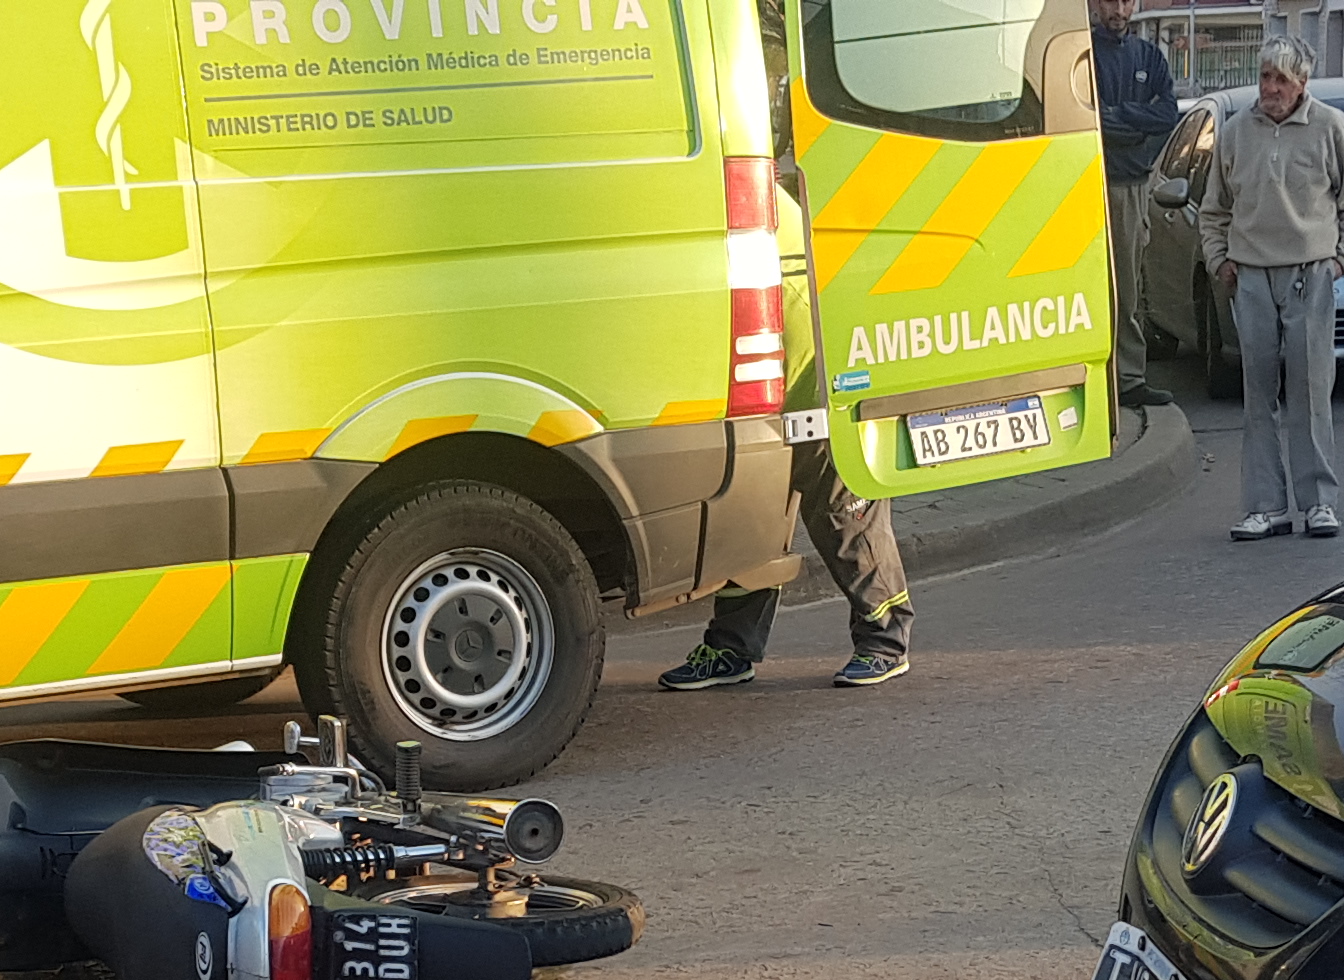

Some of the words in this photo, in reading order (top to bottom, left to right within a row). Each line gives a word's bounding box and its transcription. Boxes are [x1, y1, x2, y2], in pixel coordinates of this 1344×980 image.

[190, 0, 650, 47] PROVINCIA
[200, 62, 288, 82] Sistema
[295, 59, 321, 77] de
[328, 54, 420, 76] Atención
[426, 51, 500, 71] Médica
[506, 49, 530, 66] de
[536, 43, 652, 67] Emergencia
[206, 112, 339, 137] MINISTERIO
[346, 110, 375, 129] DE
[382, 106, 454, 127] SALUD
[847, 293, 1093, 368] AMBULANCIA
[920, 429, 950, 459] AB
[955, 419, 1000, 452] 267
[1008, 413, 1039, 443] BY
[342, 917, 376, 978] 314
[377, 916, 411, 980] DUH
